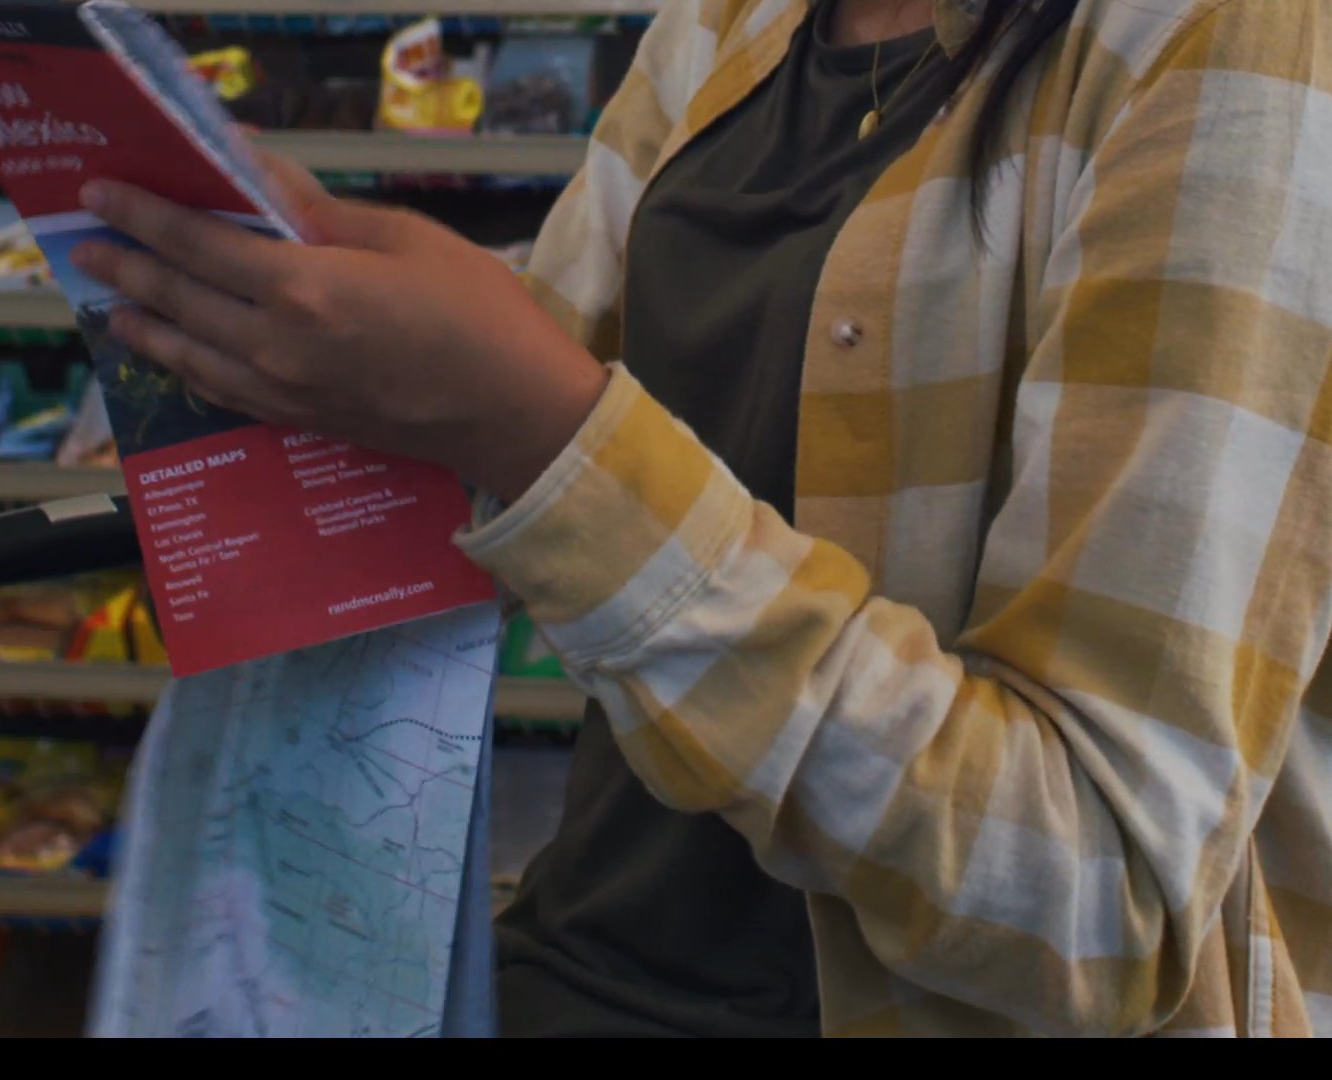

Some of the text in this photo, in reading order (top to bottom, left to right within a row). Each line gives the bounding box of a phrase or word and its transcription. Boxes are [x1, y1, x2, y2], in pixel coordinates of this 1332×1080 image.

[139, 448, 247, 484] DETAILED MAPS
[185, 496, 199, 507] TX
[328, 580, 434, 615] randmcnally.com
